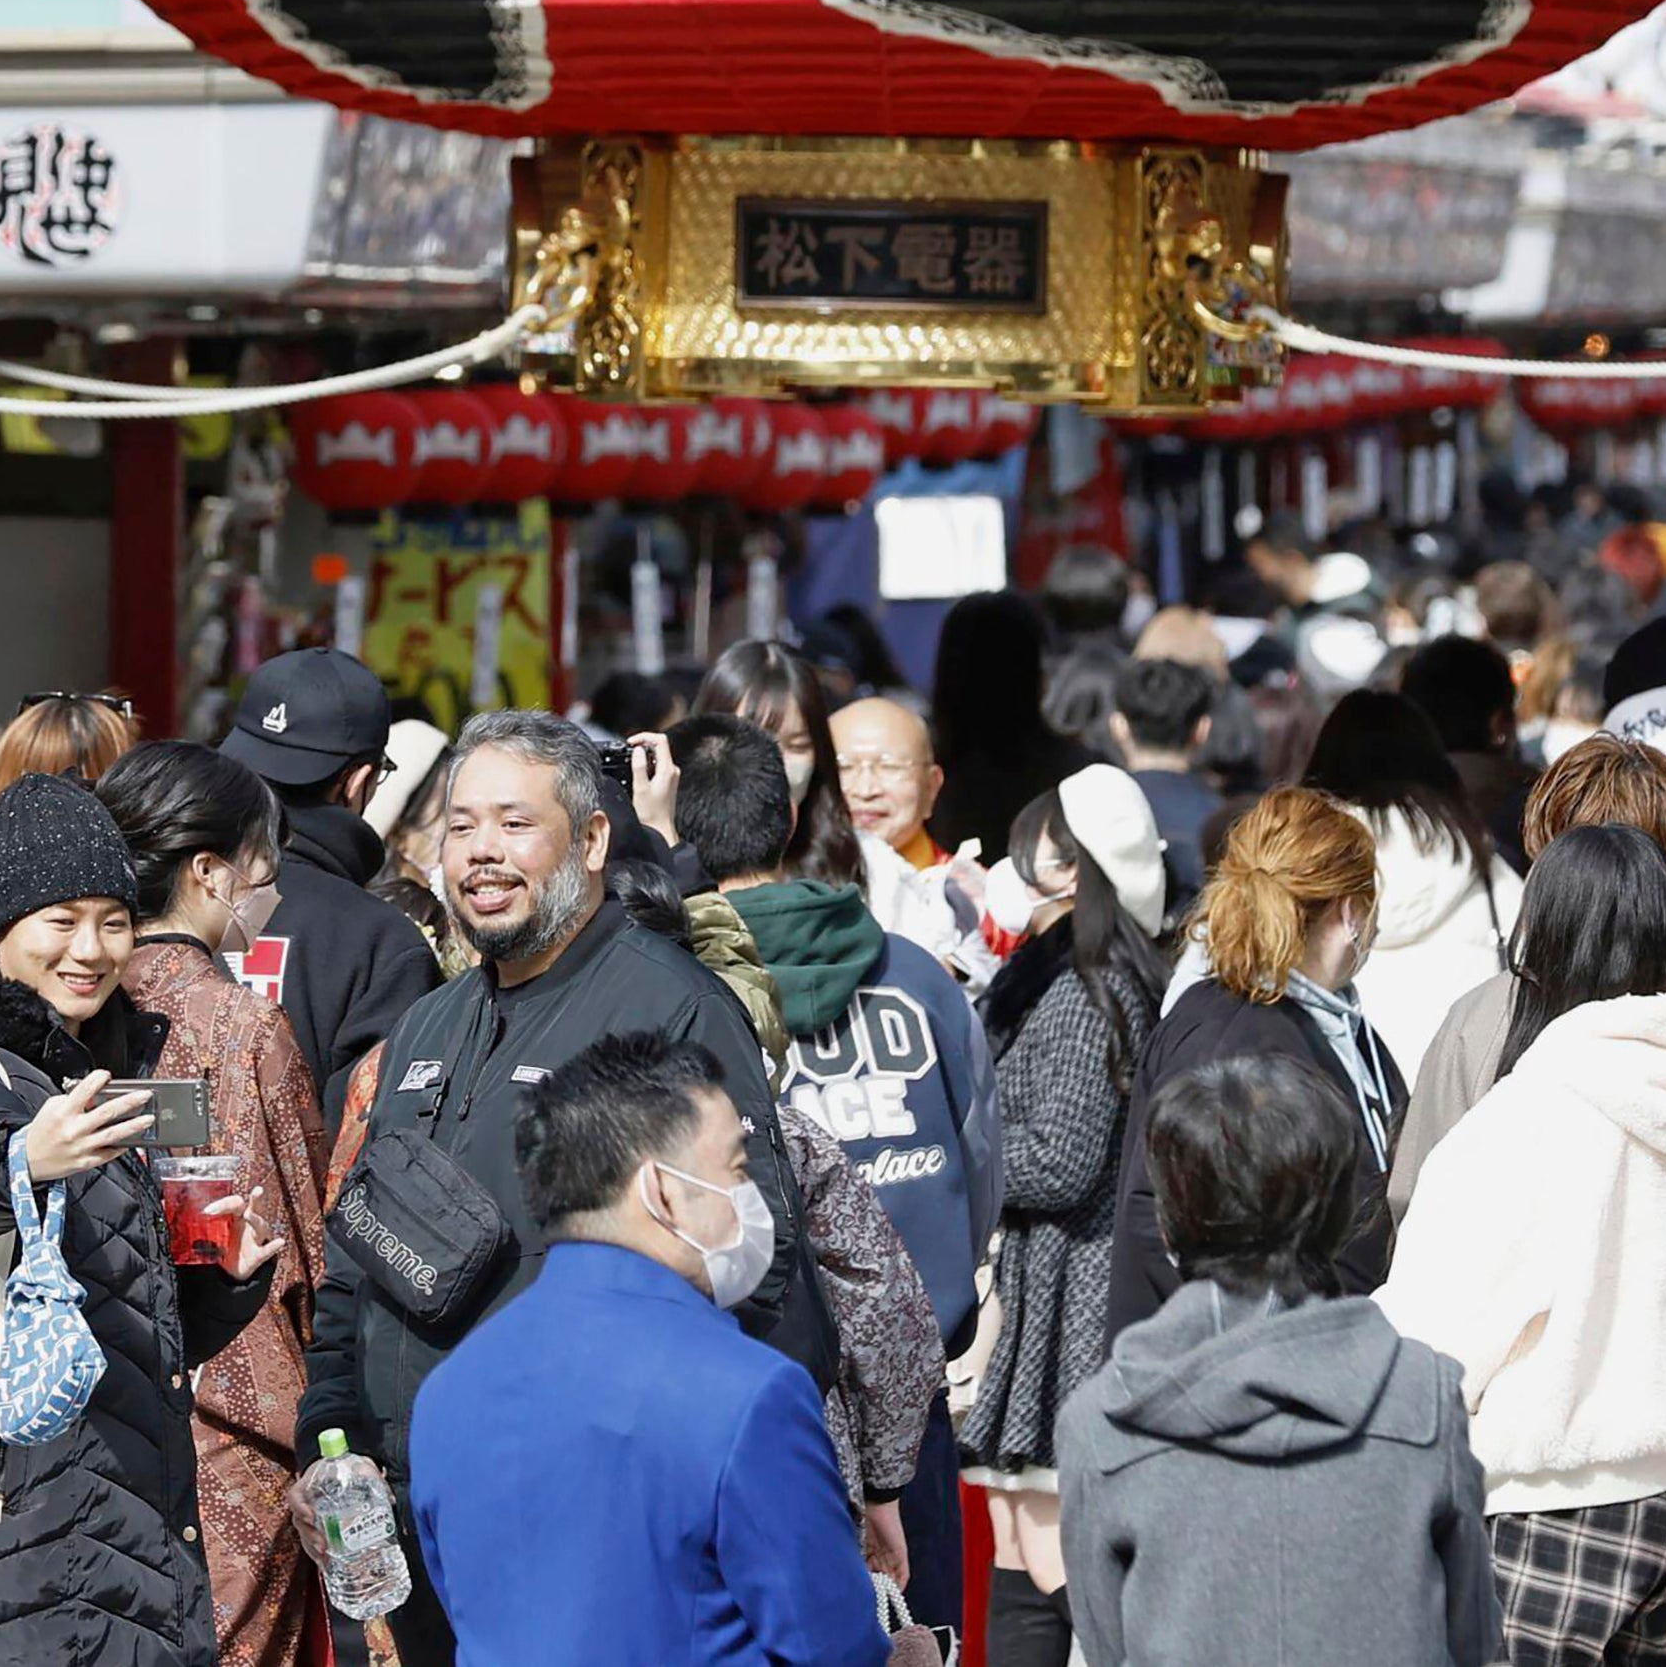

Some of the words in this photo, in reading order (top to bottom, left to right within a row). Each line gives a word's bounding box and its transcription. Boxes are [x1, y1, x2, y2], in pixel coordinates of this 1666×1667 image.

[755, 216, 1029, 296] 松下電器
[337, 1182, 438, 1295] Supreme
